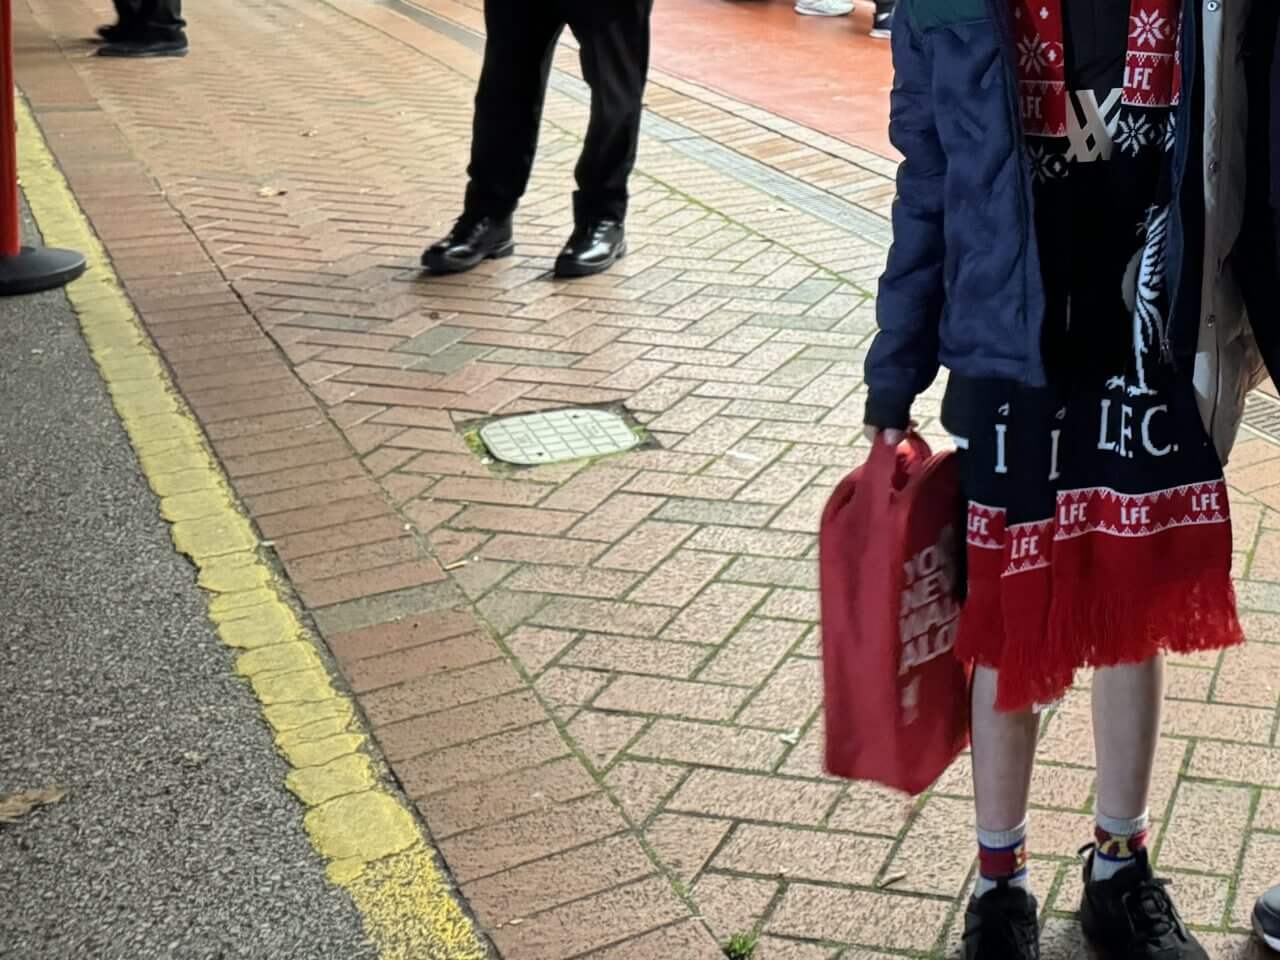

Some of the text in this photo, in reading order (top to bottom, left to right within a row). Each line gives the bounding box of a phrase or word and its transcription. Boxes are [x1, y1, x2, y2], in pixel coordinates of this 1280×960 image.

[1123, 66, 1153, 90] LFC
[1059, 502, 1087, 525] LFC
[1191, 492, 1220, 512] LFC
[1121, 506, 1150, 525] LFC
[1011, 535, 1039, 560] LFC
